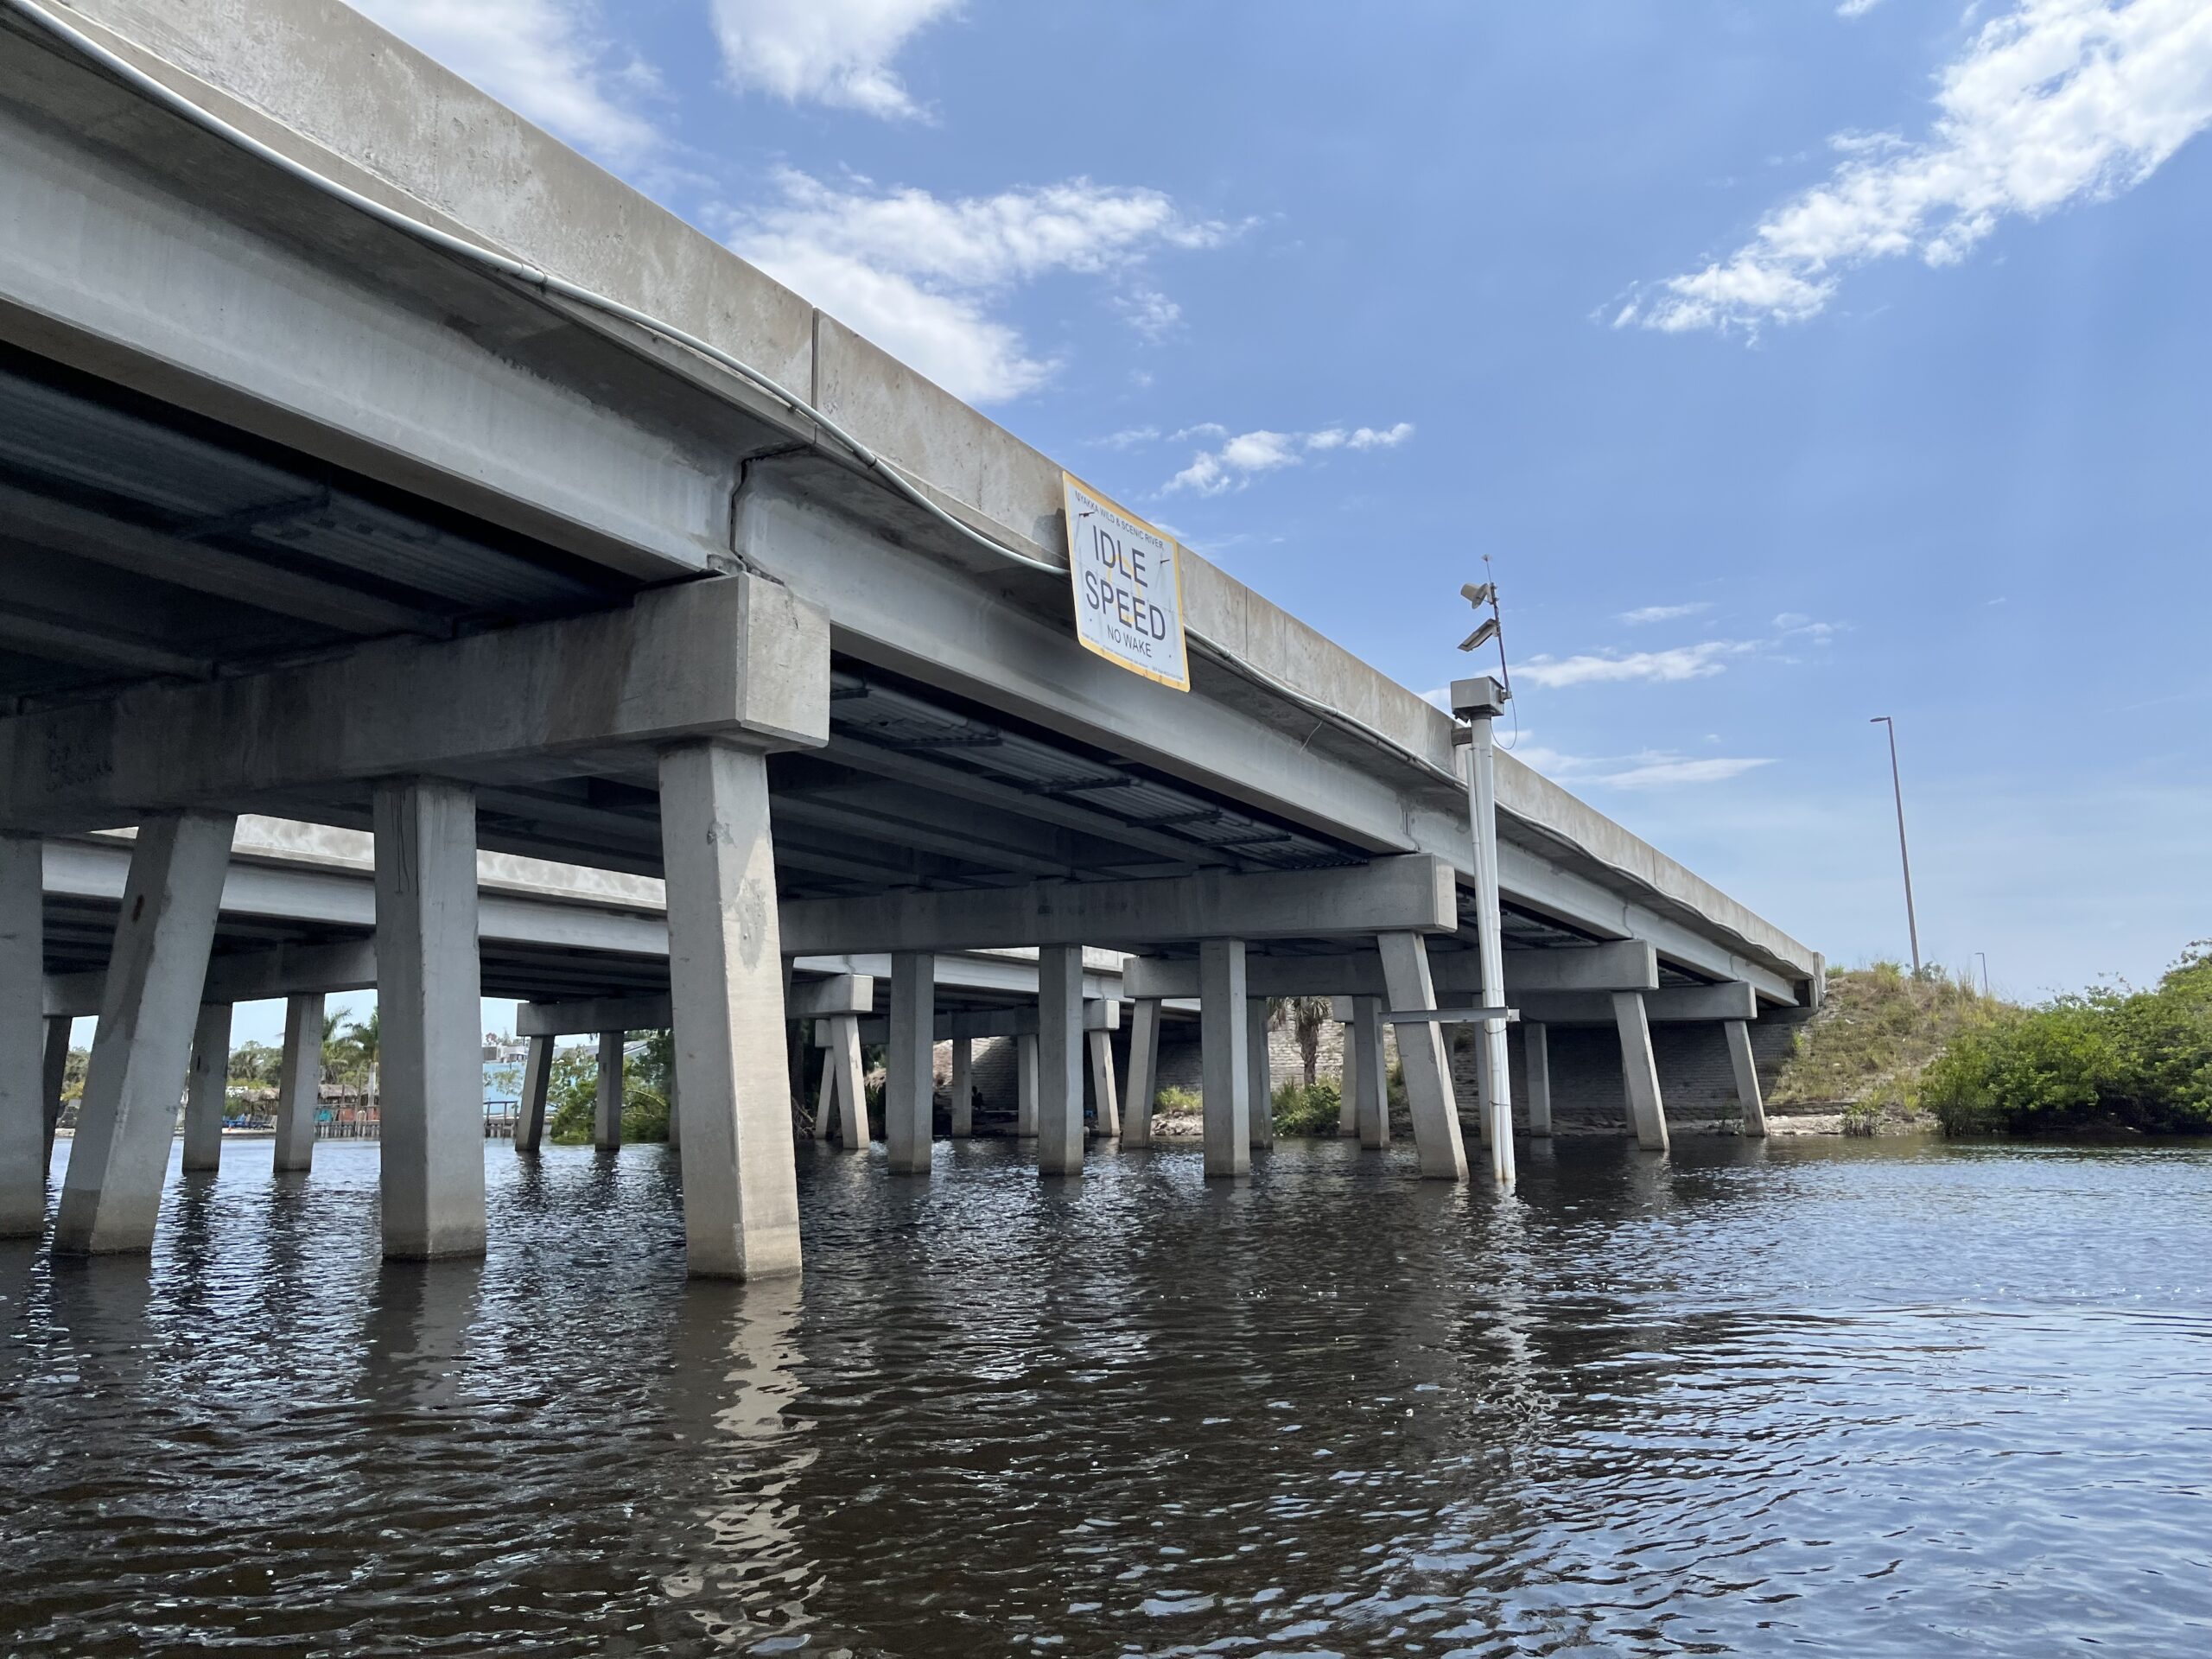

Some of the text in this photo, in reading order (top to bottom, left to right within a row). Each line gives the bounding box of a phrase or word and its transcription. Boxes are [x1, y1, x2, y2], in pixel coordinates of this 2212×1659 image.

[1100, 509, 1115, 524] WILD
[1122, 521, 1144, 540] SCENIC
[1145, 533, 1164, 548] RIVER
[1093, 524, 1148, 588] IDLE
[1085, 570, 1166, 641] SPEED
[1107, 624, 1122, 644] NO
[1123, 632, 1153, 658] WAKE
